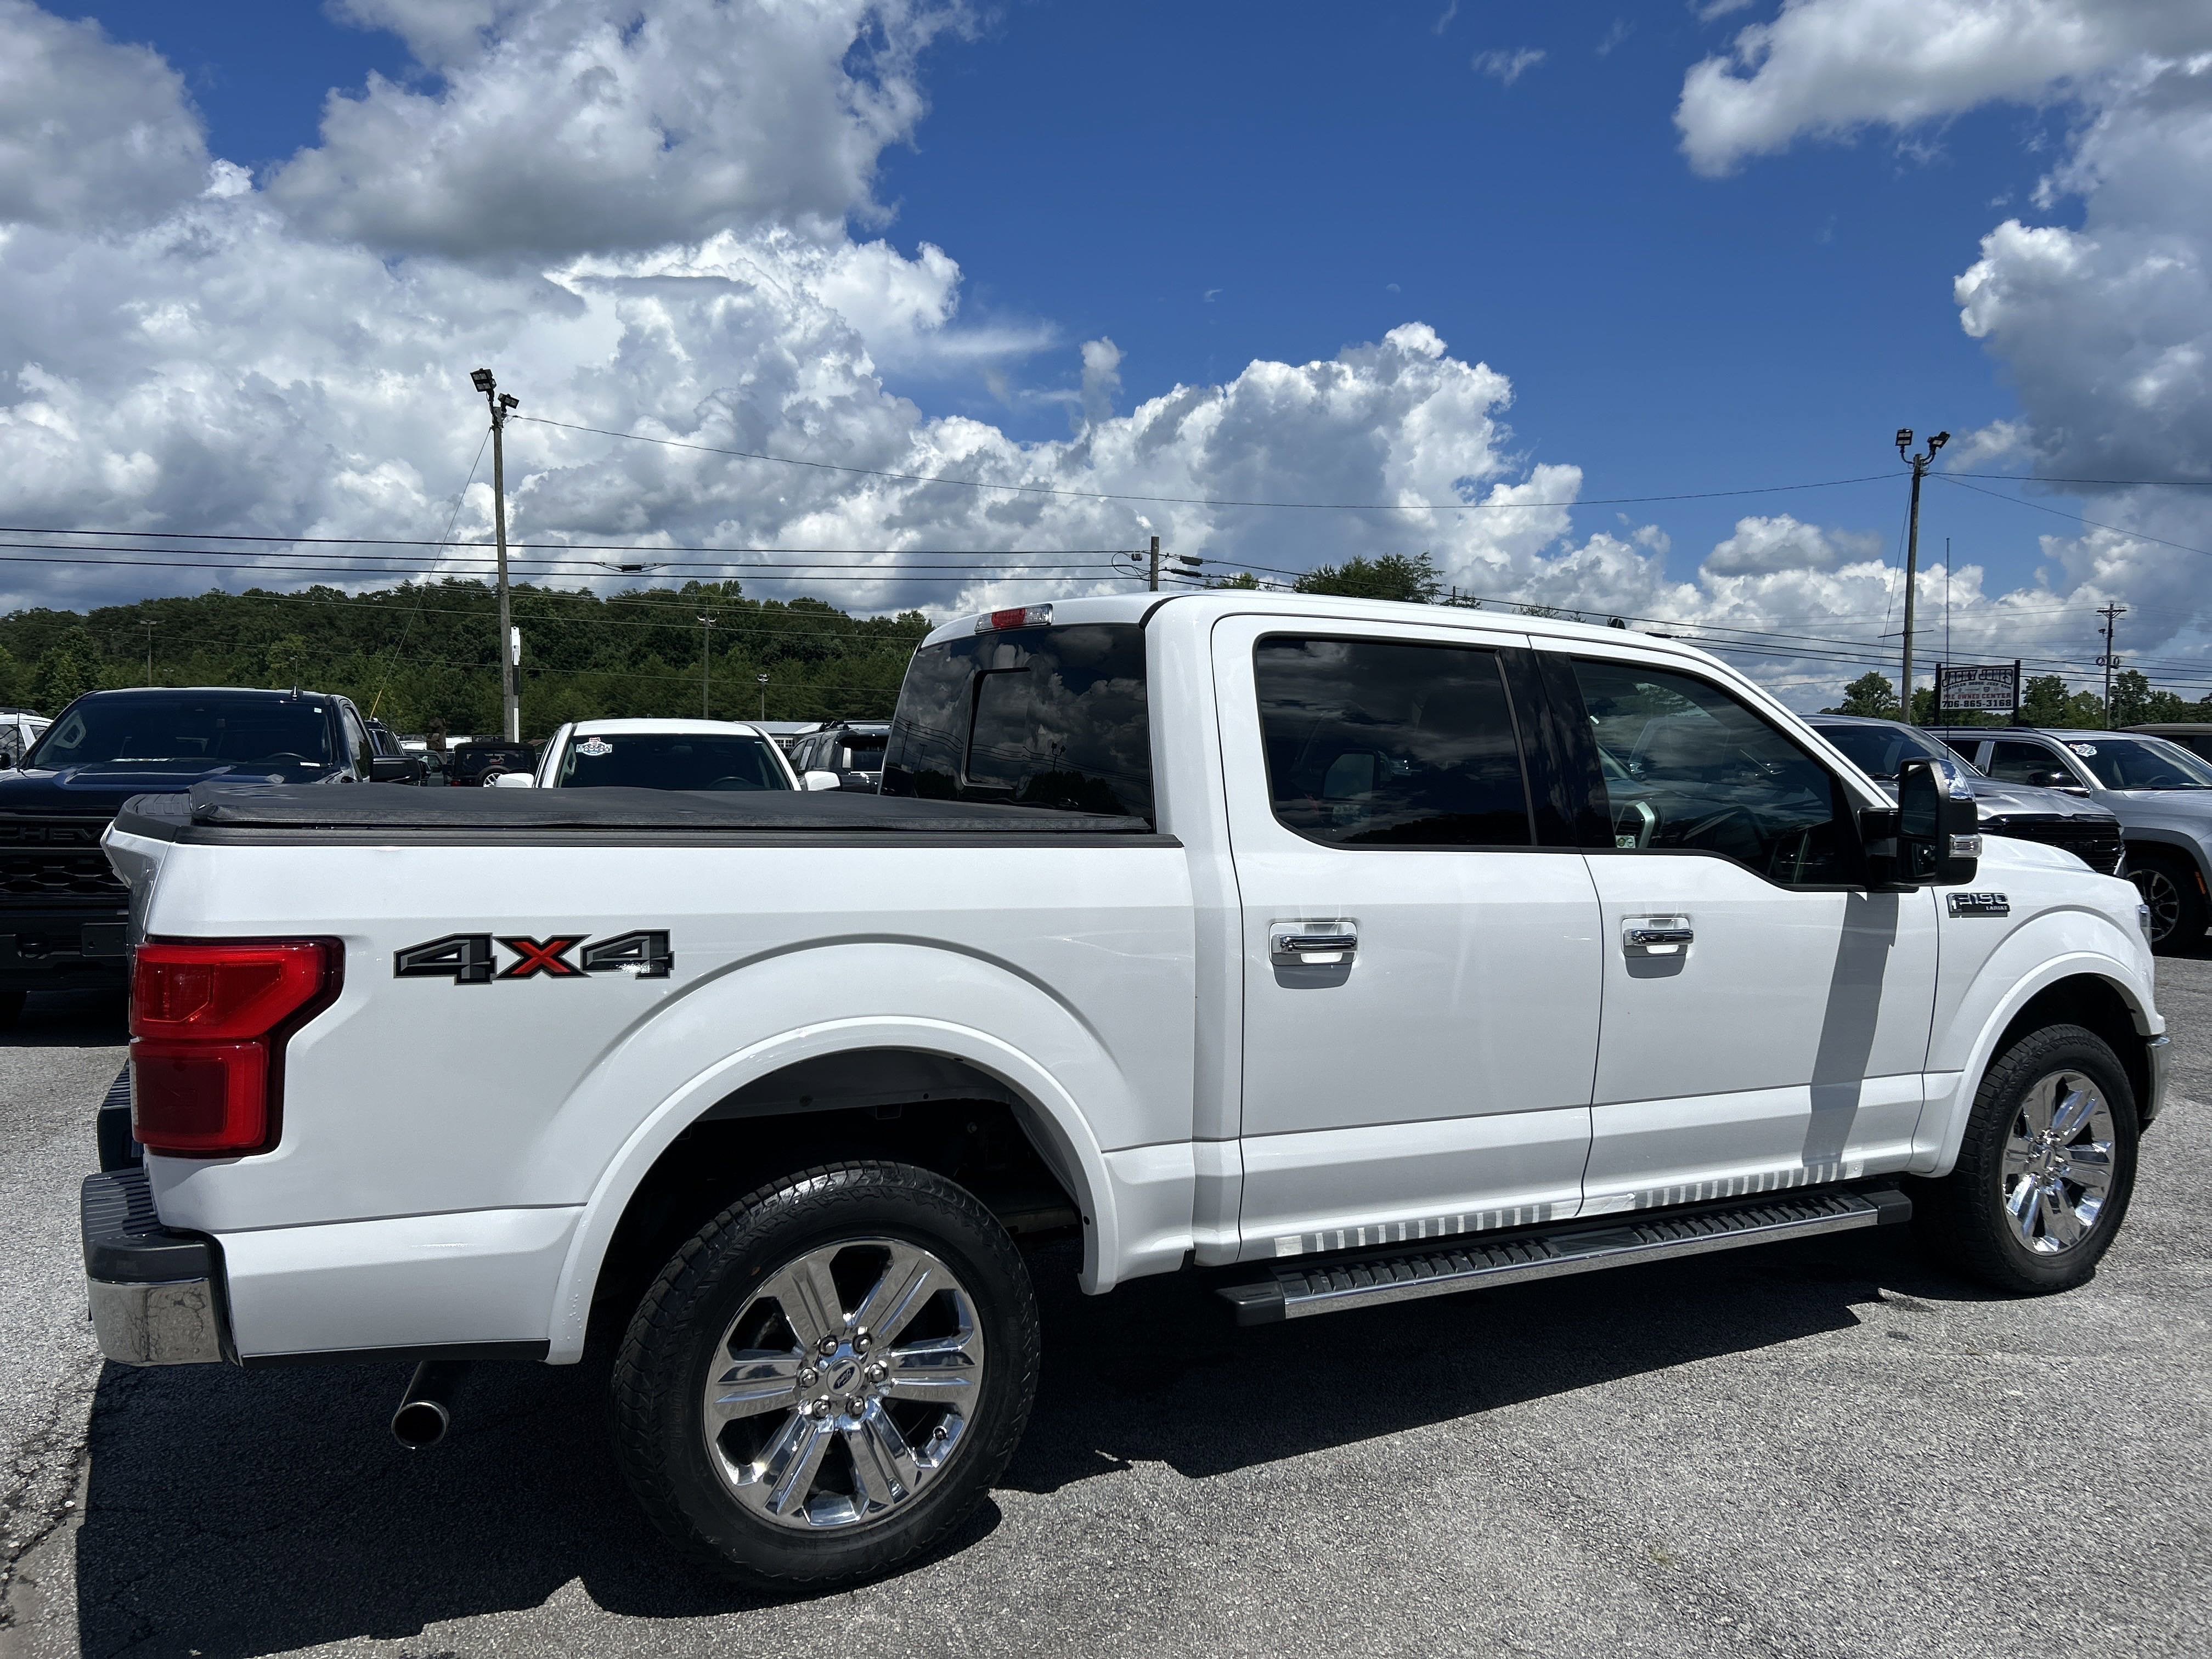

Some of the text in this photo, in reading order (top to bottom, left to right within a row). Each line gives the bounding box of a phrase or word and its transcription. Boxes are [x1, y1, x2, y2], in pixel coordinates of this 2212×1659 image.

[1942, 669, 2012, 687] JACKY JONES
[393, 928, 675, 986] 4X4
